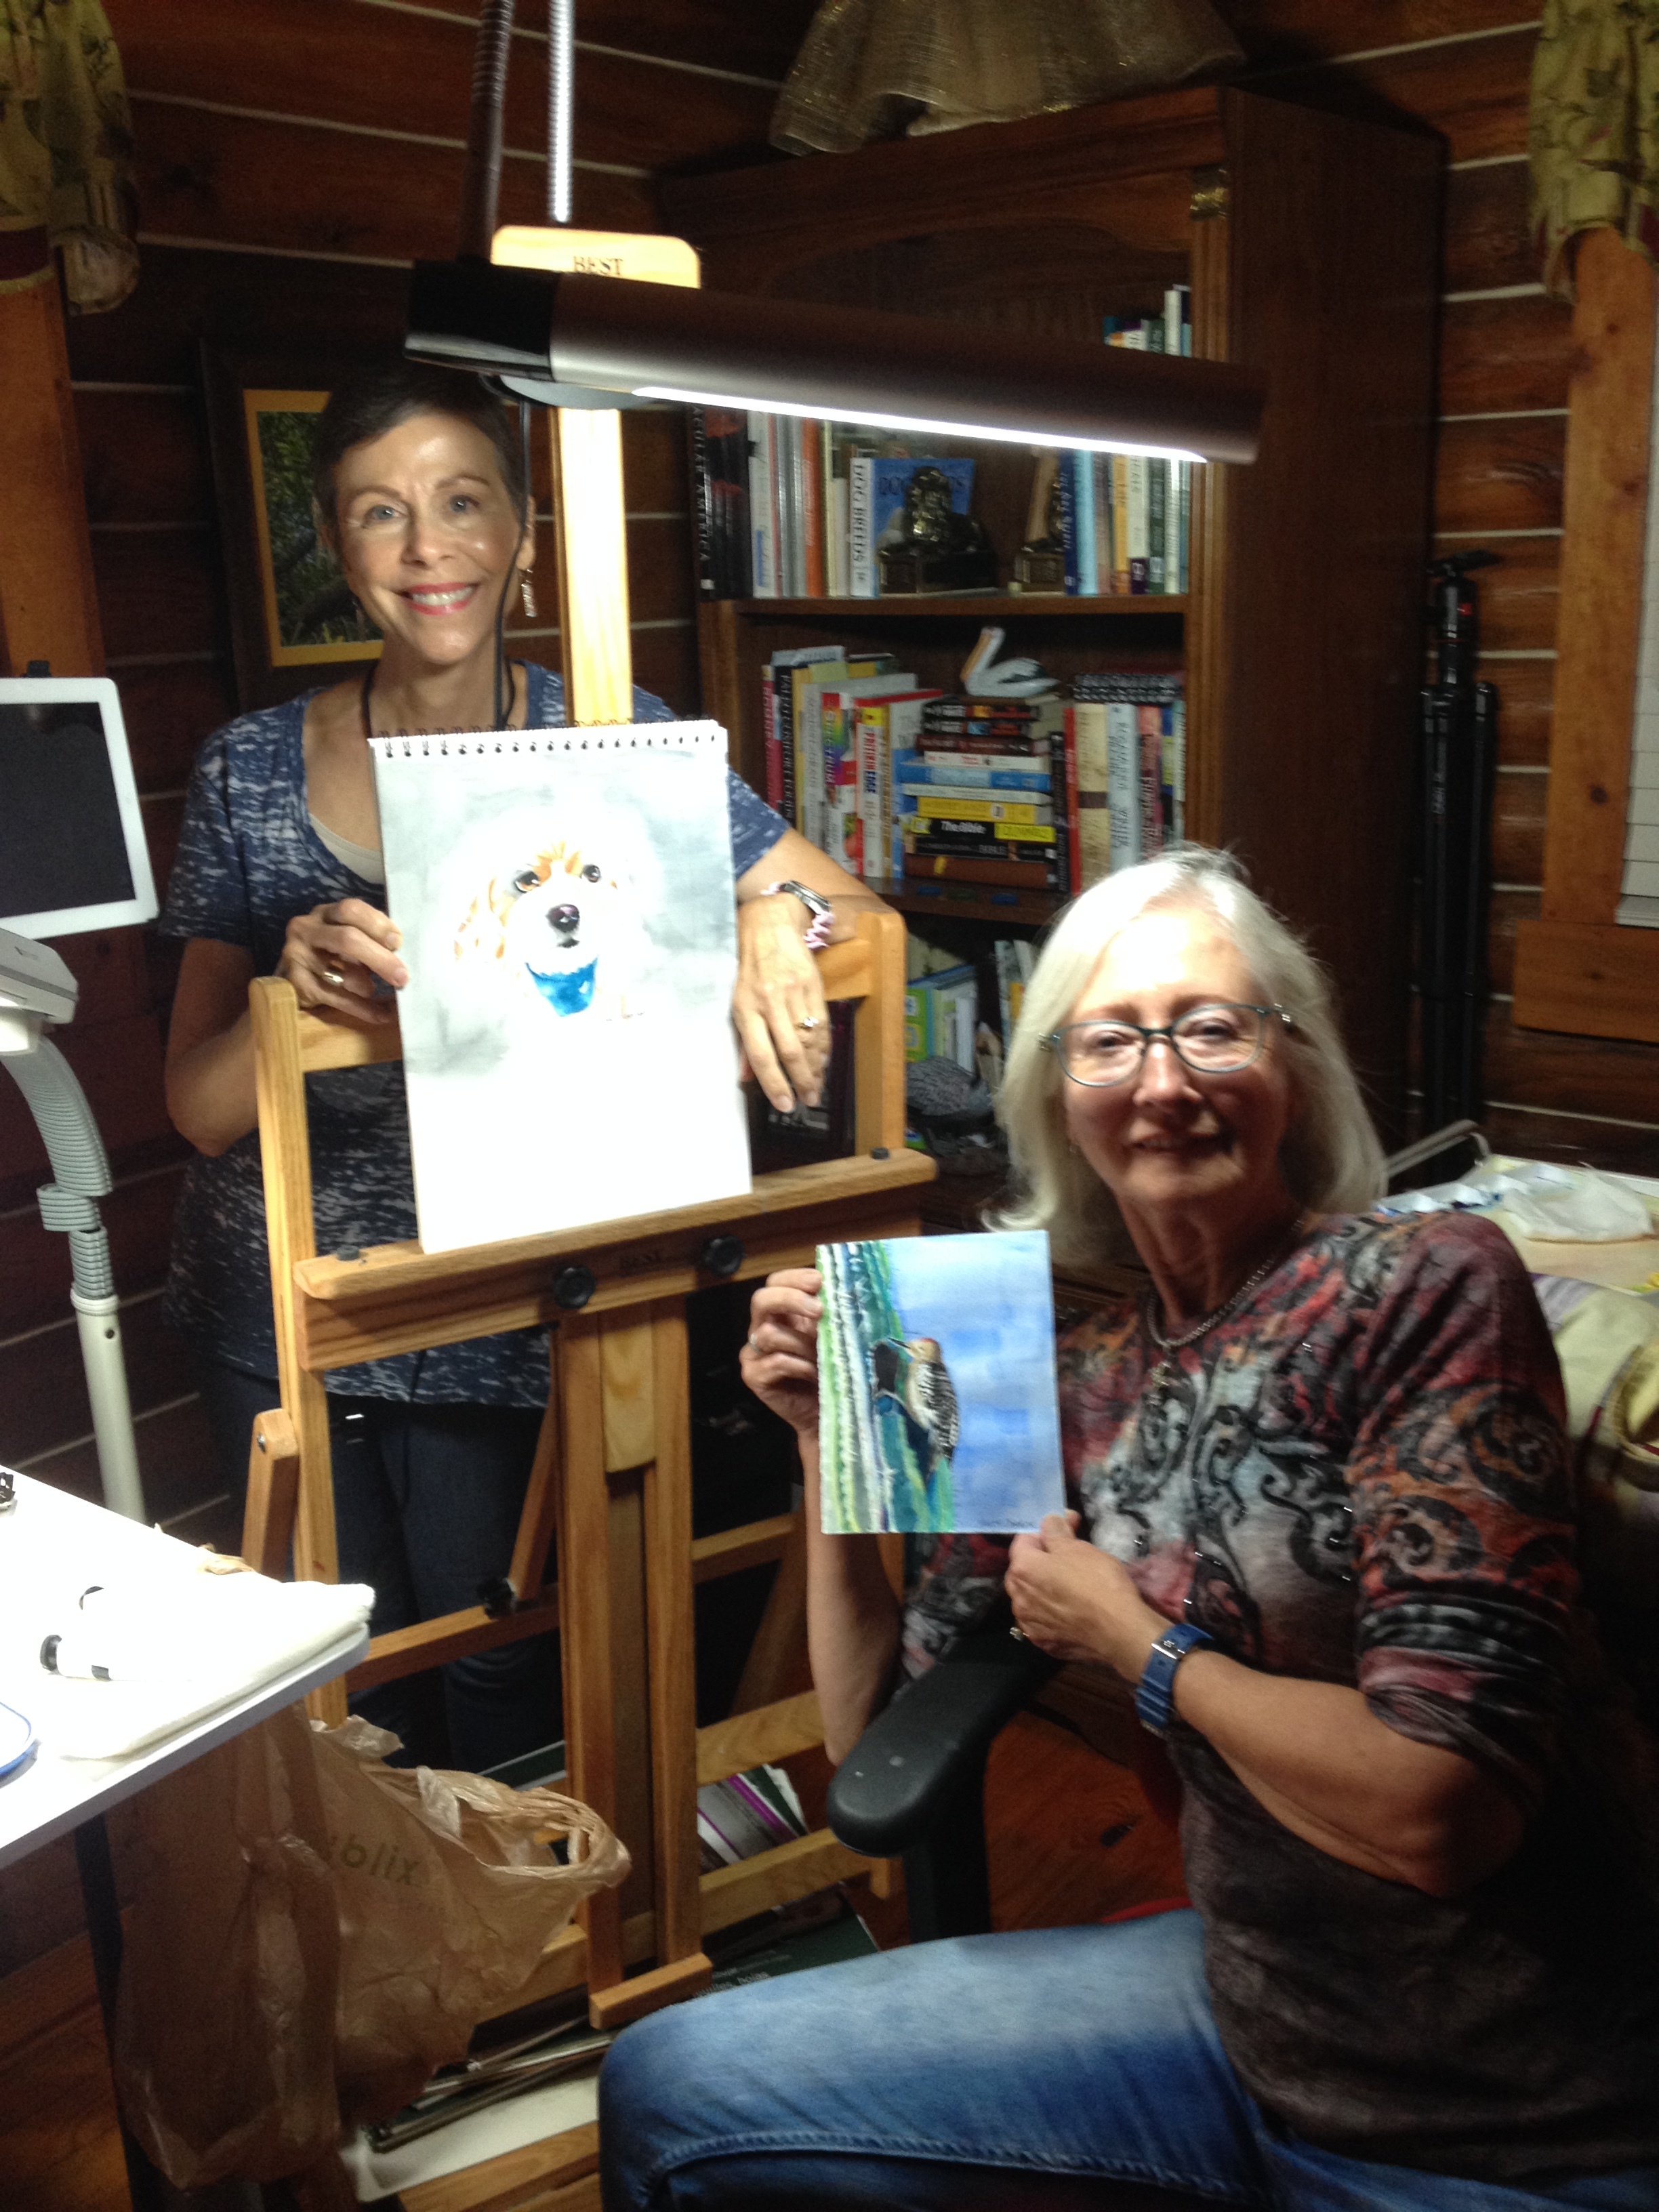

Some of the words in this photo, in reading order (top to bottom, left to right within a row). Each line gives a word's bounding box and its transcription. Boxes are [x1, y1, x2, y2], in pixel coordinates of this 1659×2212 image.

[572, 255, 623, 276] BEST
[692, 405, 706, 474] ACULAR
[853, 464, 868, 501] DOG
[695, 483, 712, 562] AMERICA
[853, 506, 870, 564] BREEDS
[865, 771, 878, 794] EDGE
[341, 1833, 421, 1886] blix
